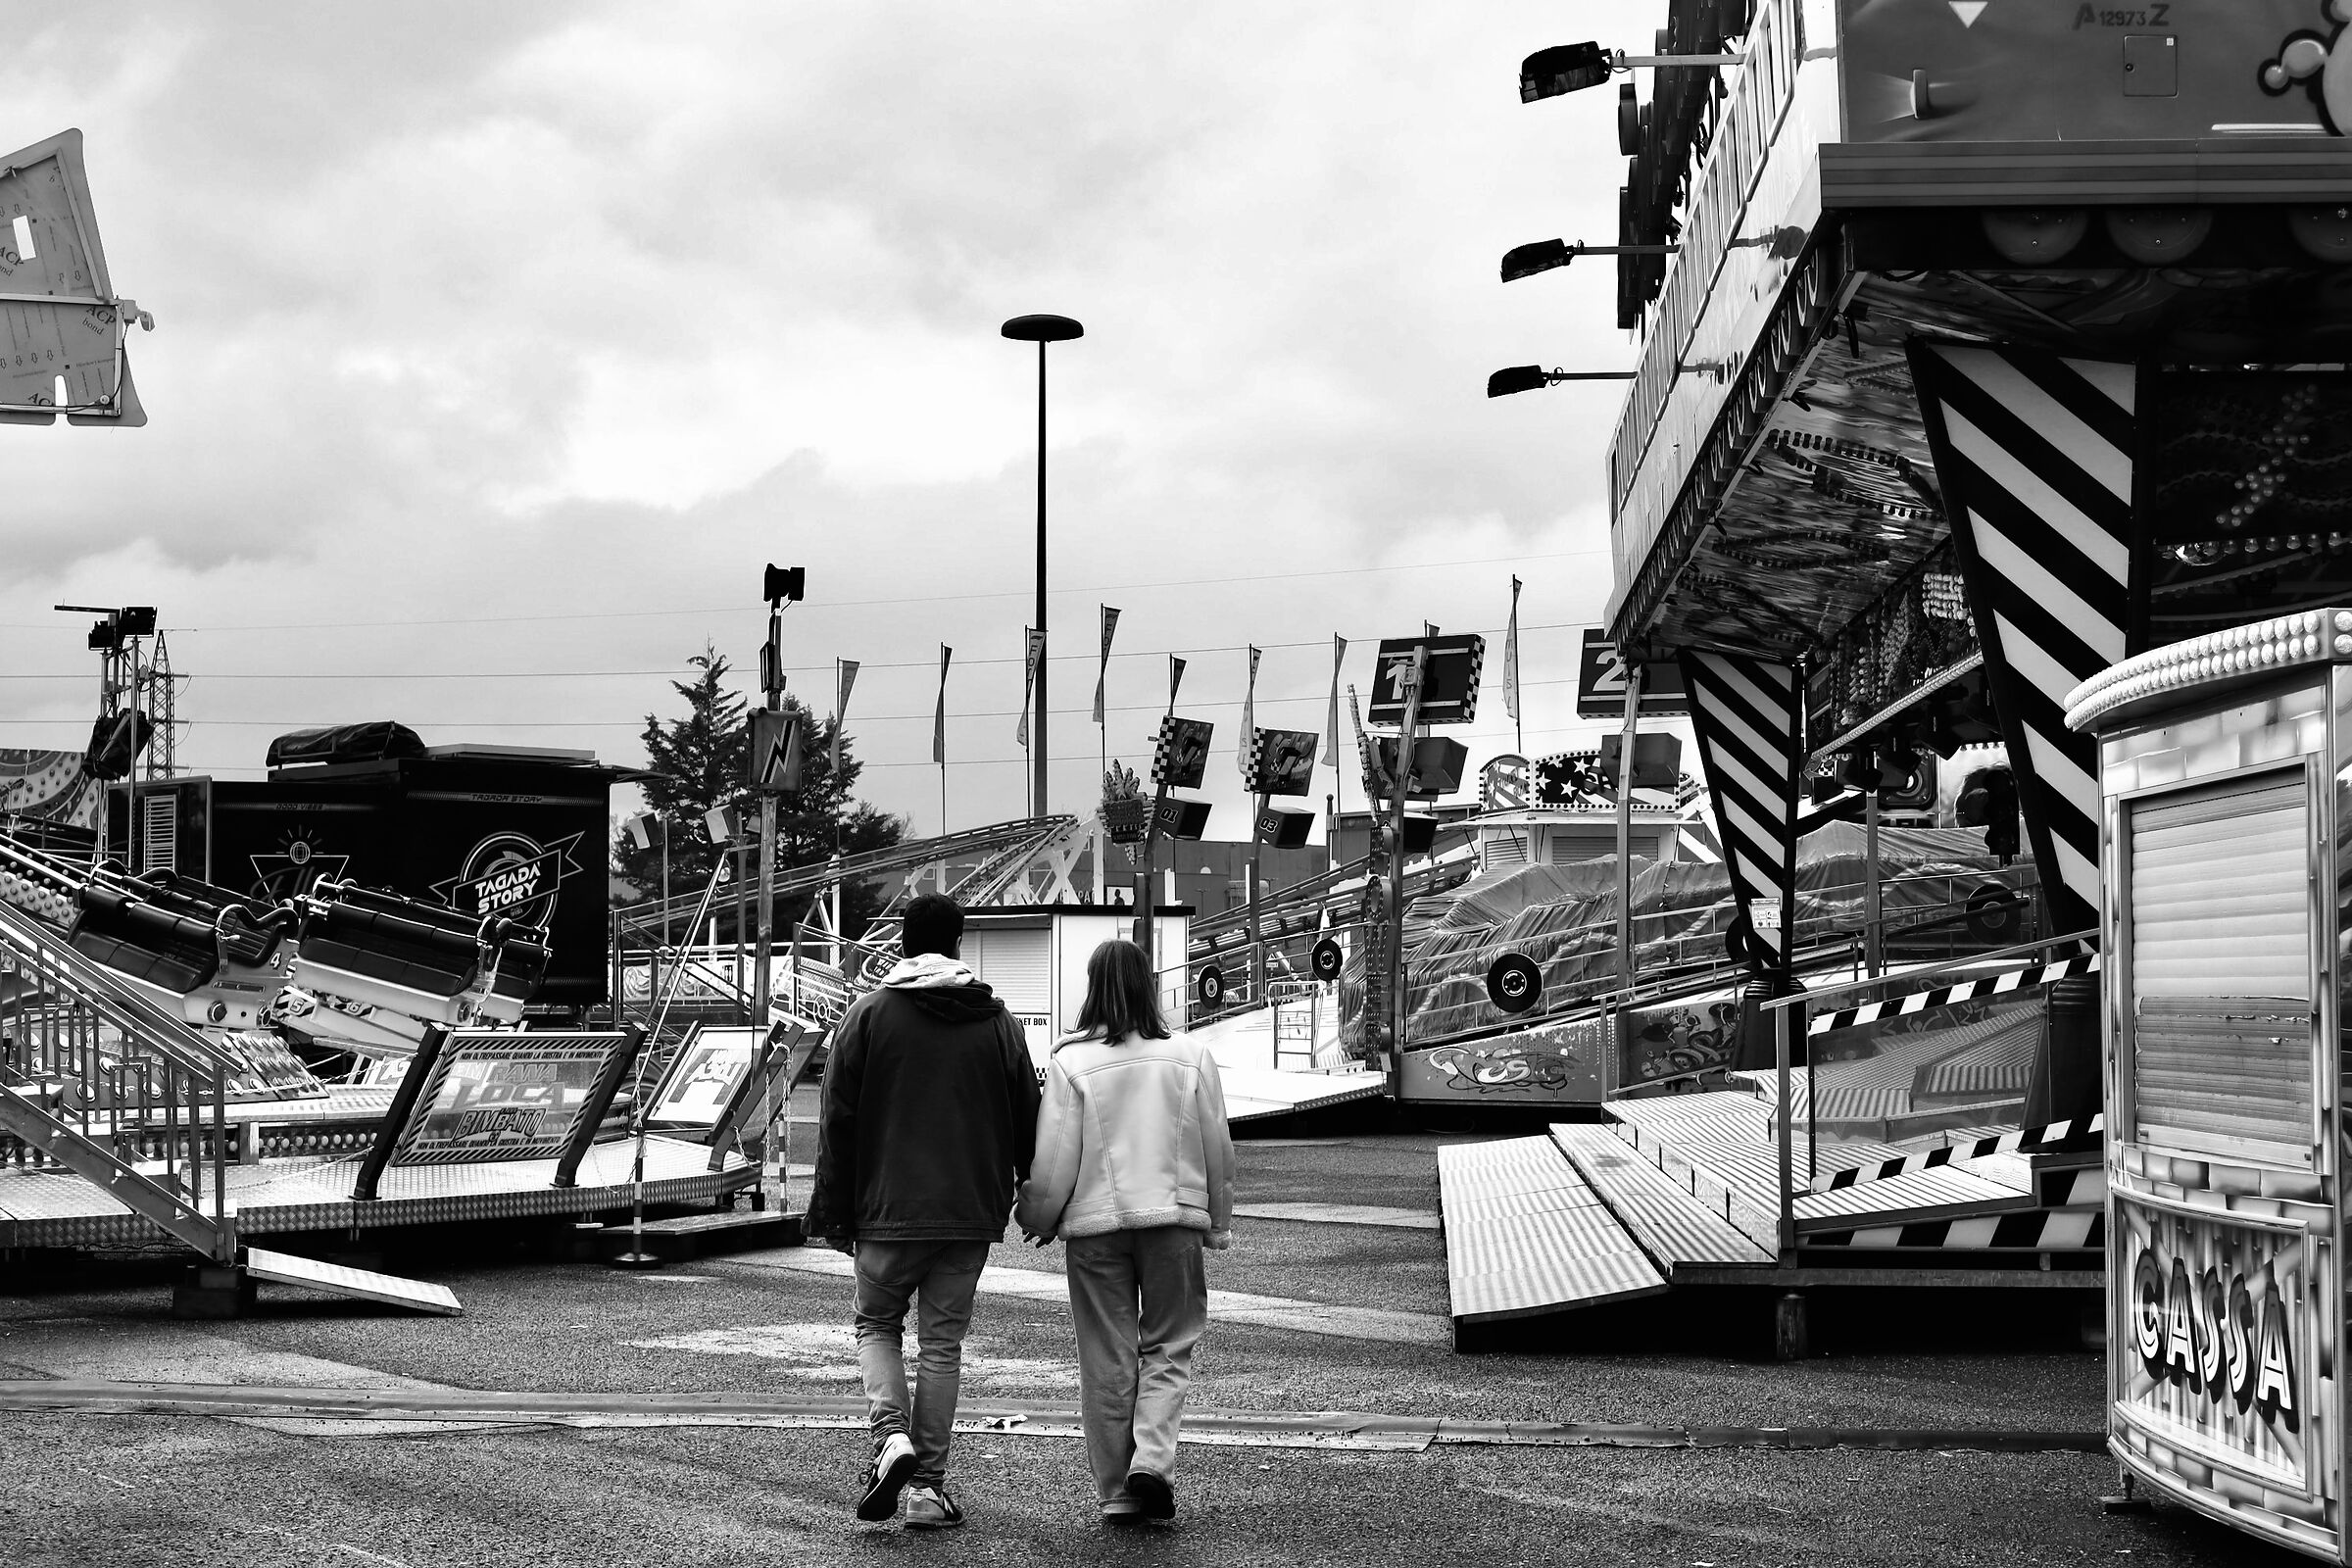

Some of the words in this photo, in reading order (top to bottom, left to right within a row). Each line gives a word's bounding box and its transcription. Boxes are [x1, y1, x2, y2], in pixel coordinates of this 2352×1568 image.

[2099, 10, 2146, 27] 12973
[2148, 3, 2171, 27] Z
[85, 305, 117, 325] ACP
[81, 317, 105, 335] bond
[1592, 650, 1626, 692] 2
[1160, 807, 1178, 824] 01
[1258, 816, 1278, 833] 03
[477, 878, 539, 915] STORY
[270, 952, 282, 969] 4
[289, 999, 306, 1013] 5
[348, 1002, 362, 1013] 6
[1033, 1017, 1047, 1026] BOX
[460, 1052, 472, 1060] NON
[487, 1062, 558, 1083] RANA
[452, 1082, 565, 1110] LOCA
[454, 1108, 548, 1139] BIMBATO
[2134, 1249, 2300, 1434] CASSA
